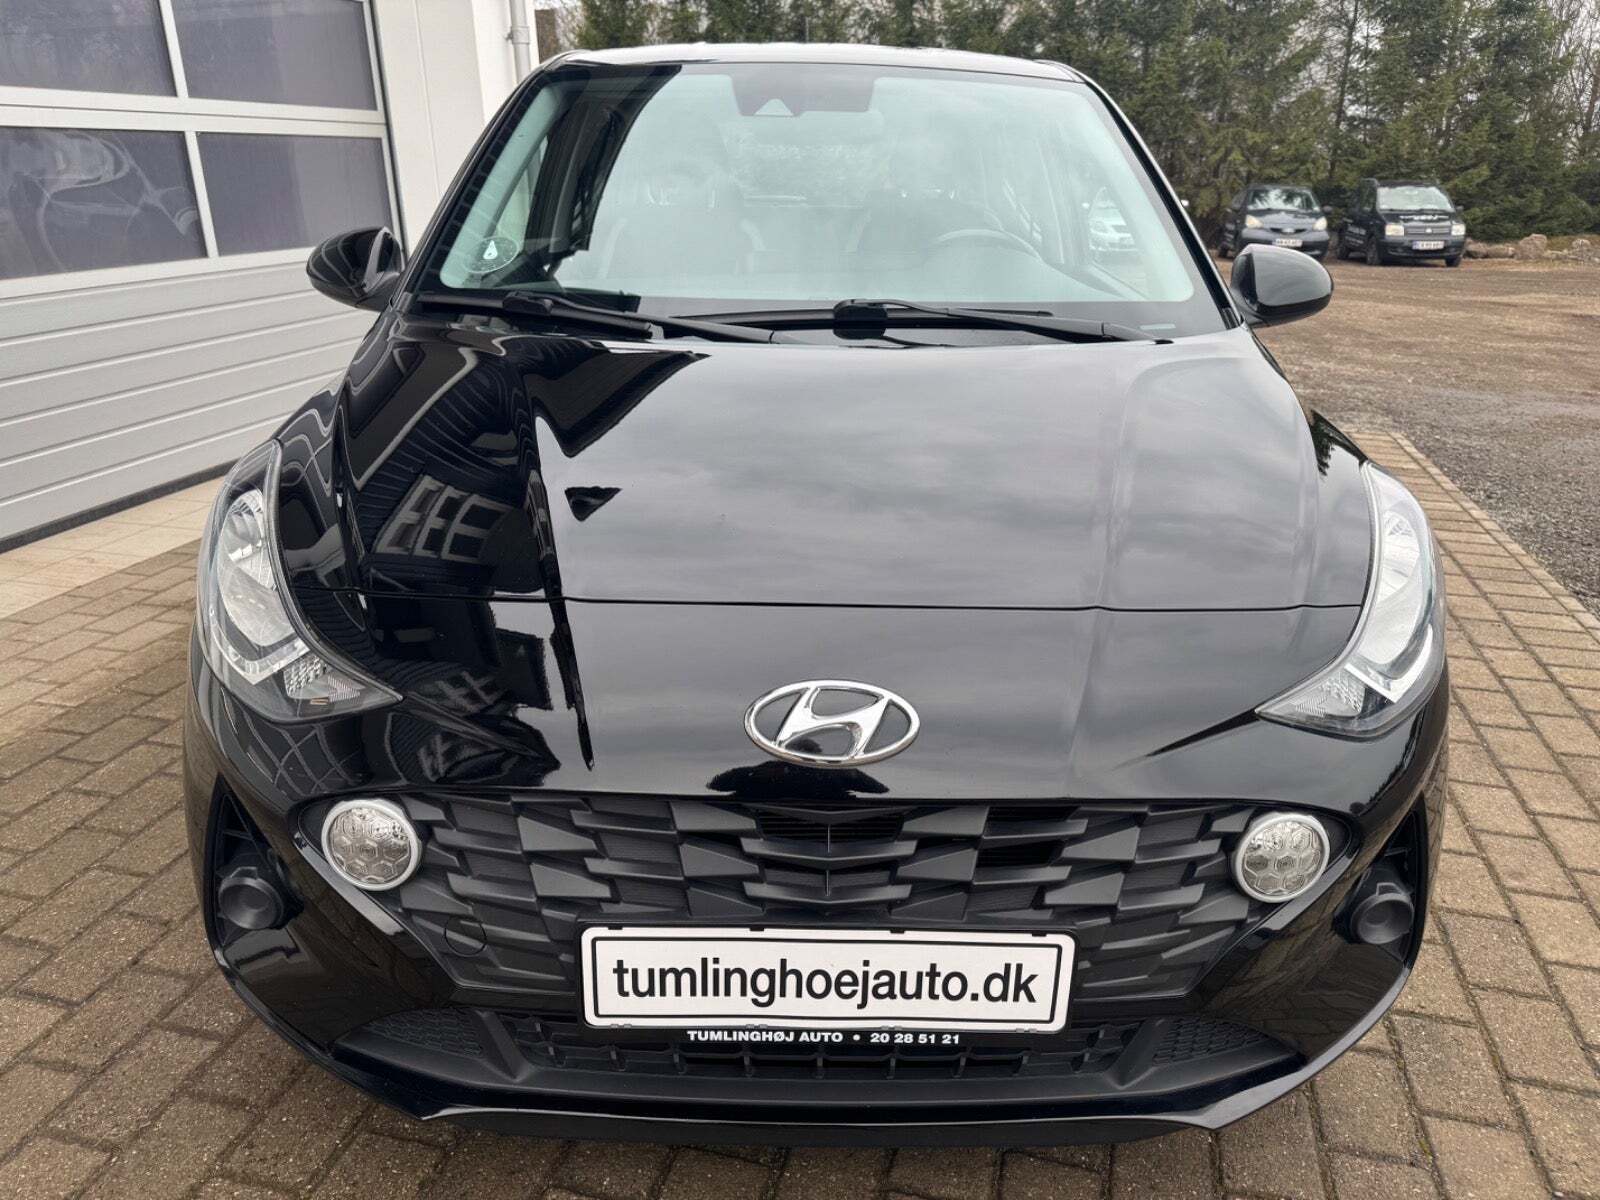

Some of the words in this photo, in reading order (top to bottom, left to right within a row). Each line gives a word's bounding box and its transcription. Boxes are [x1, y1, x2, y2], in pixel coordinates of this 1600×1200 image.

[612, 957, 1038, 1010] tumlinghoejauto.dk
[687, 1030, 794, 1042] TUMLINGHØJ
[798, 1031, 844, 1043] AUTO
[870, 1032, 890, 1044] 20
[893, 1032, 914, 1044] 28
[917, 1033, 936, 1044] 51
[941, 1034, 960, 1045] 21
